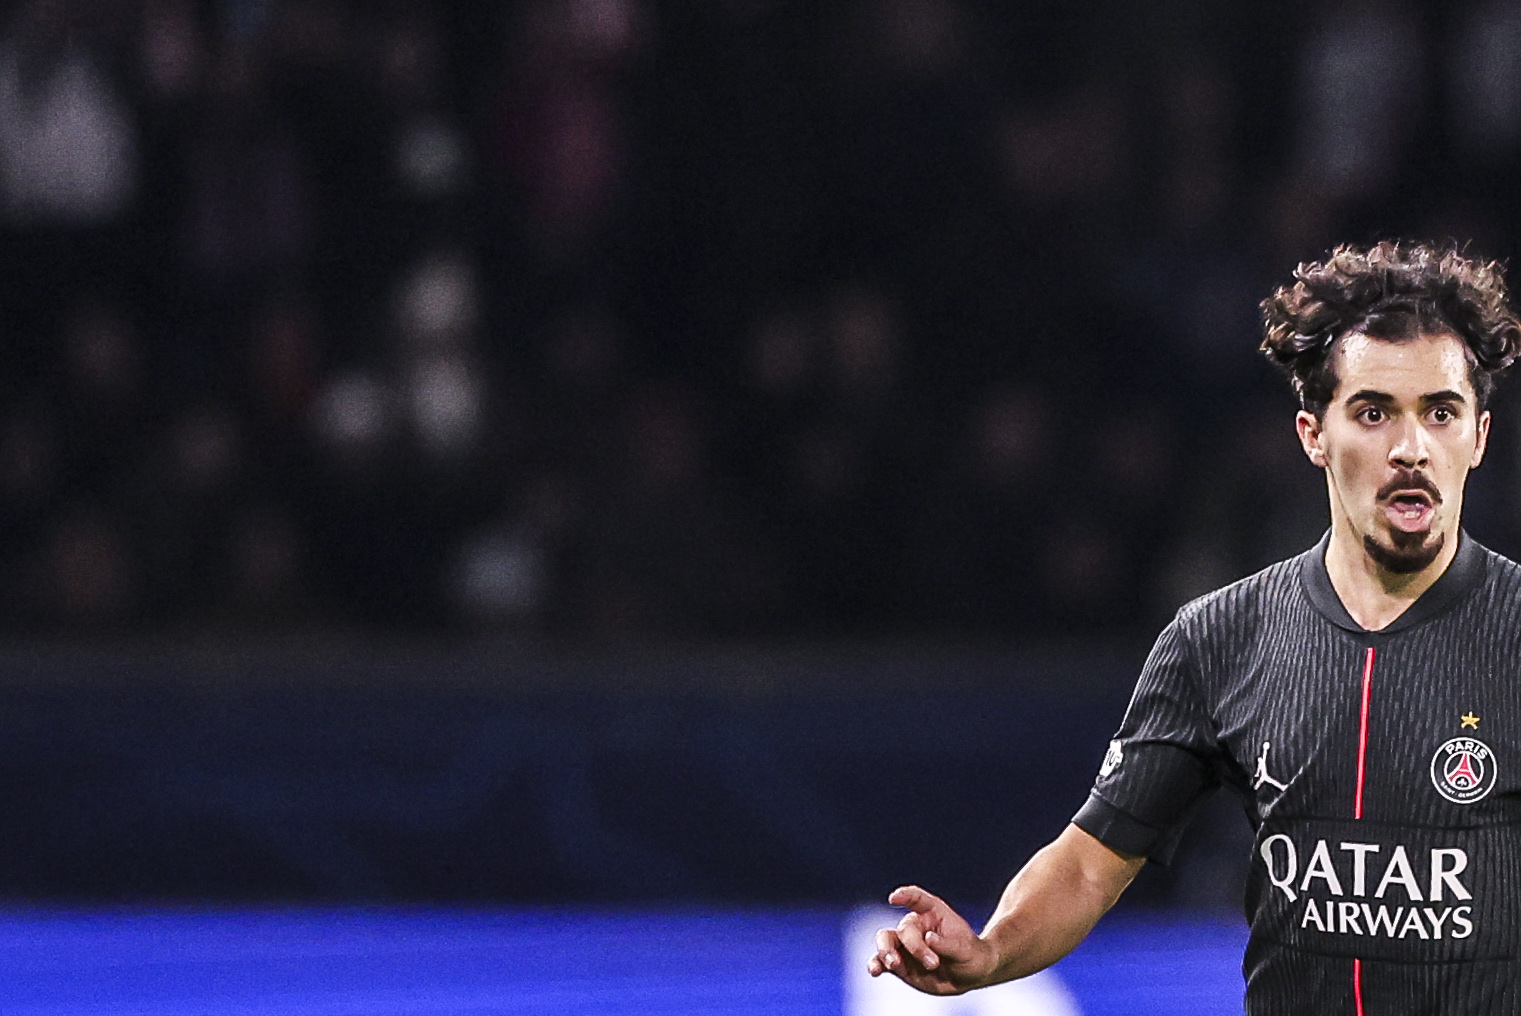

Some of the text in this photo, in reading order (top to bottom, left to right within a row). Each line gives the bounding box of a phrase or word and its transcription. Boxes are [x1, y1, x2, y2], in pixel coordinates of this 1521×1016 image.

[1444, 741, 1487, 760] PARIS
[1260, 833, 1472, 902] QATAR
[1301, 898, 1473, 940] AIRWAYS
